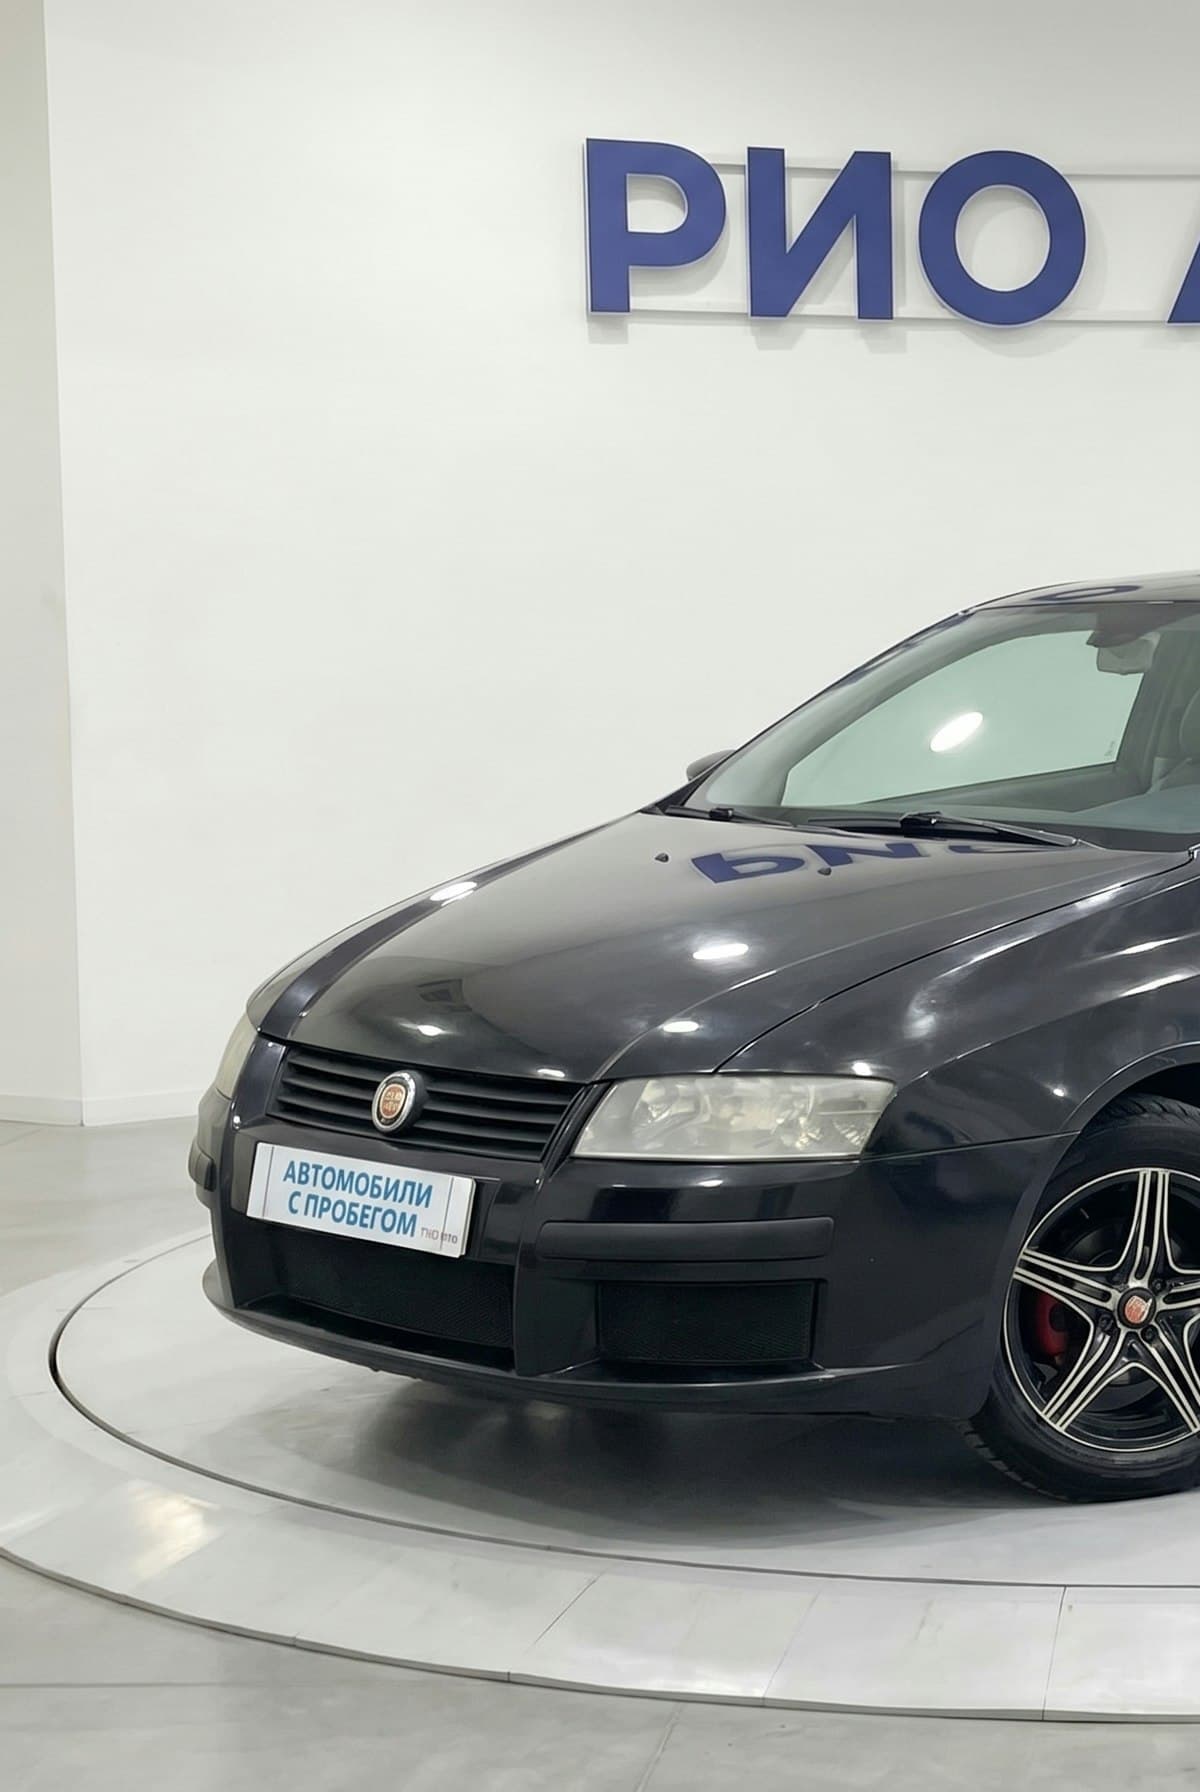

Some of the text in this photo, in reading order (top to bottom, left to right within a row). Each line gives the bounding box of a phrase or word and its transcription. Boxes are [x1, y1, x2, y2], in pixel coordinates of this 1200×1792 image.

[586, 138, 1086, 325] РИО
[283, 1160, 433, 1208] АВТОМОБИЛИ
[288, 1191, 301, 1214] С
[304, 1193, 417, 1237] ПРОБЕГОМ
